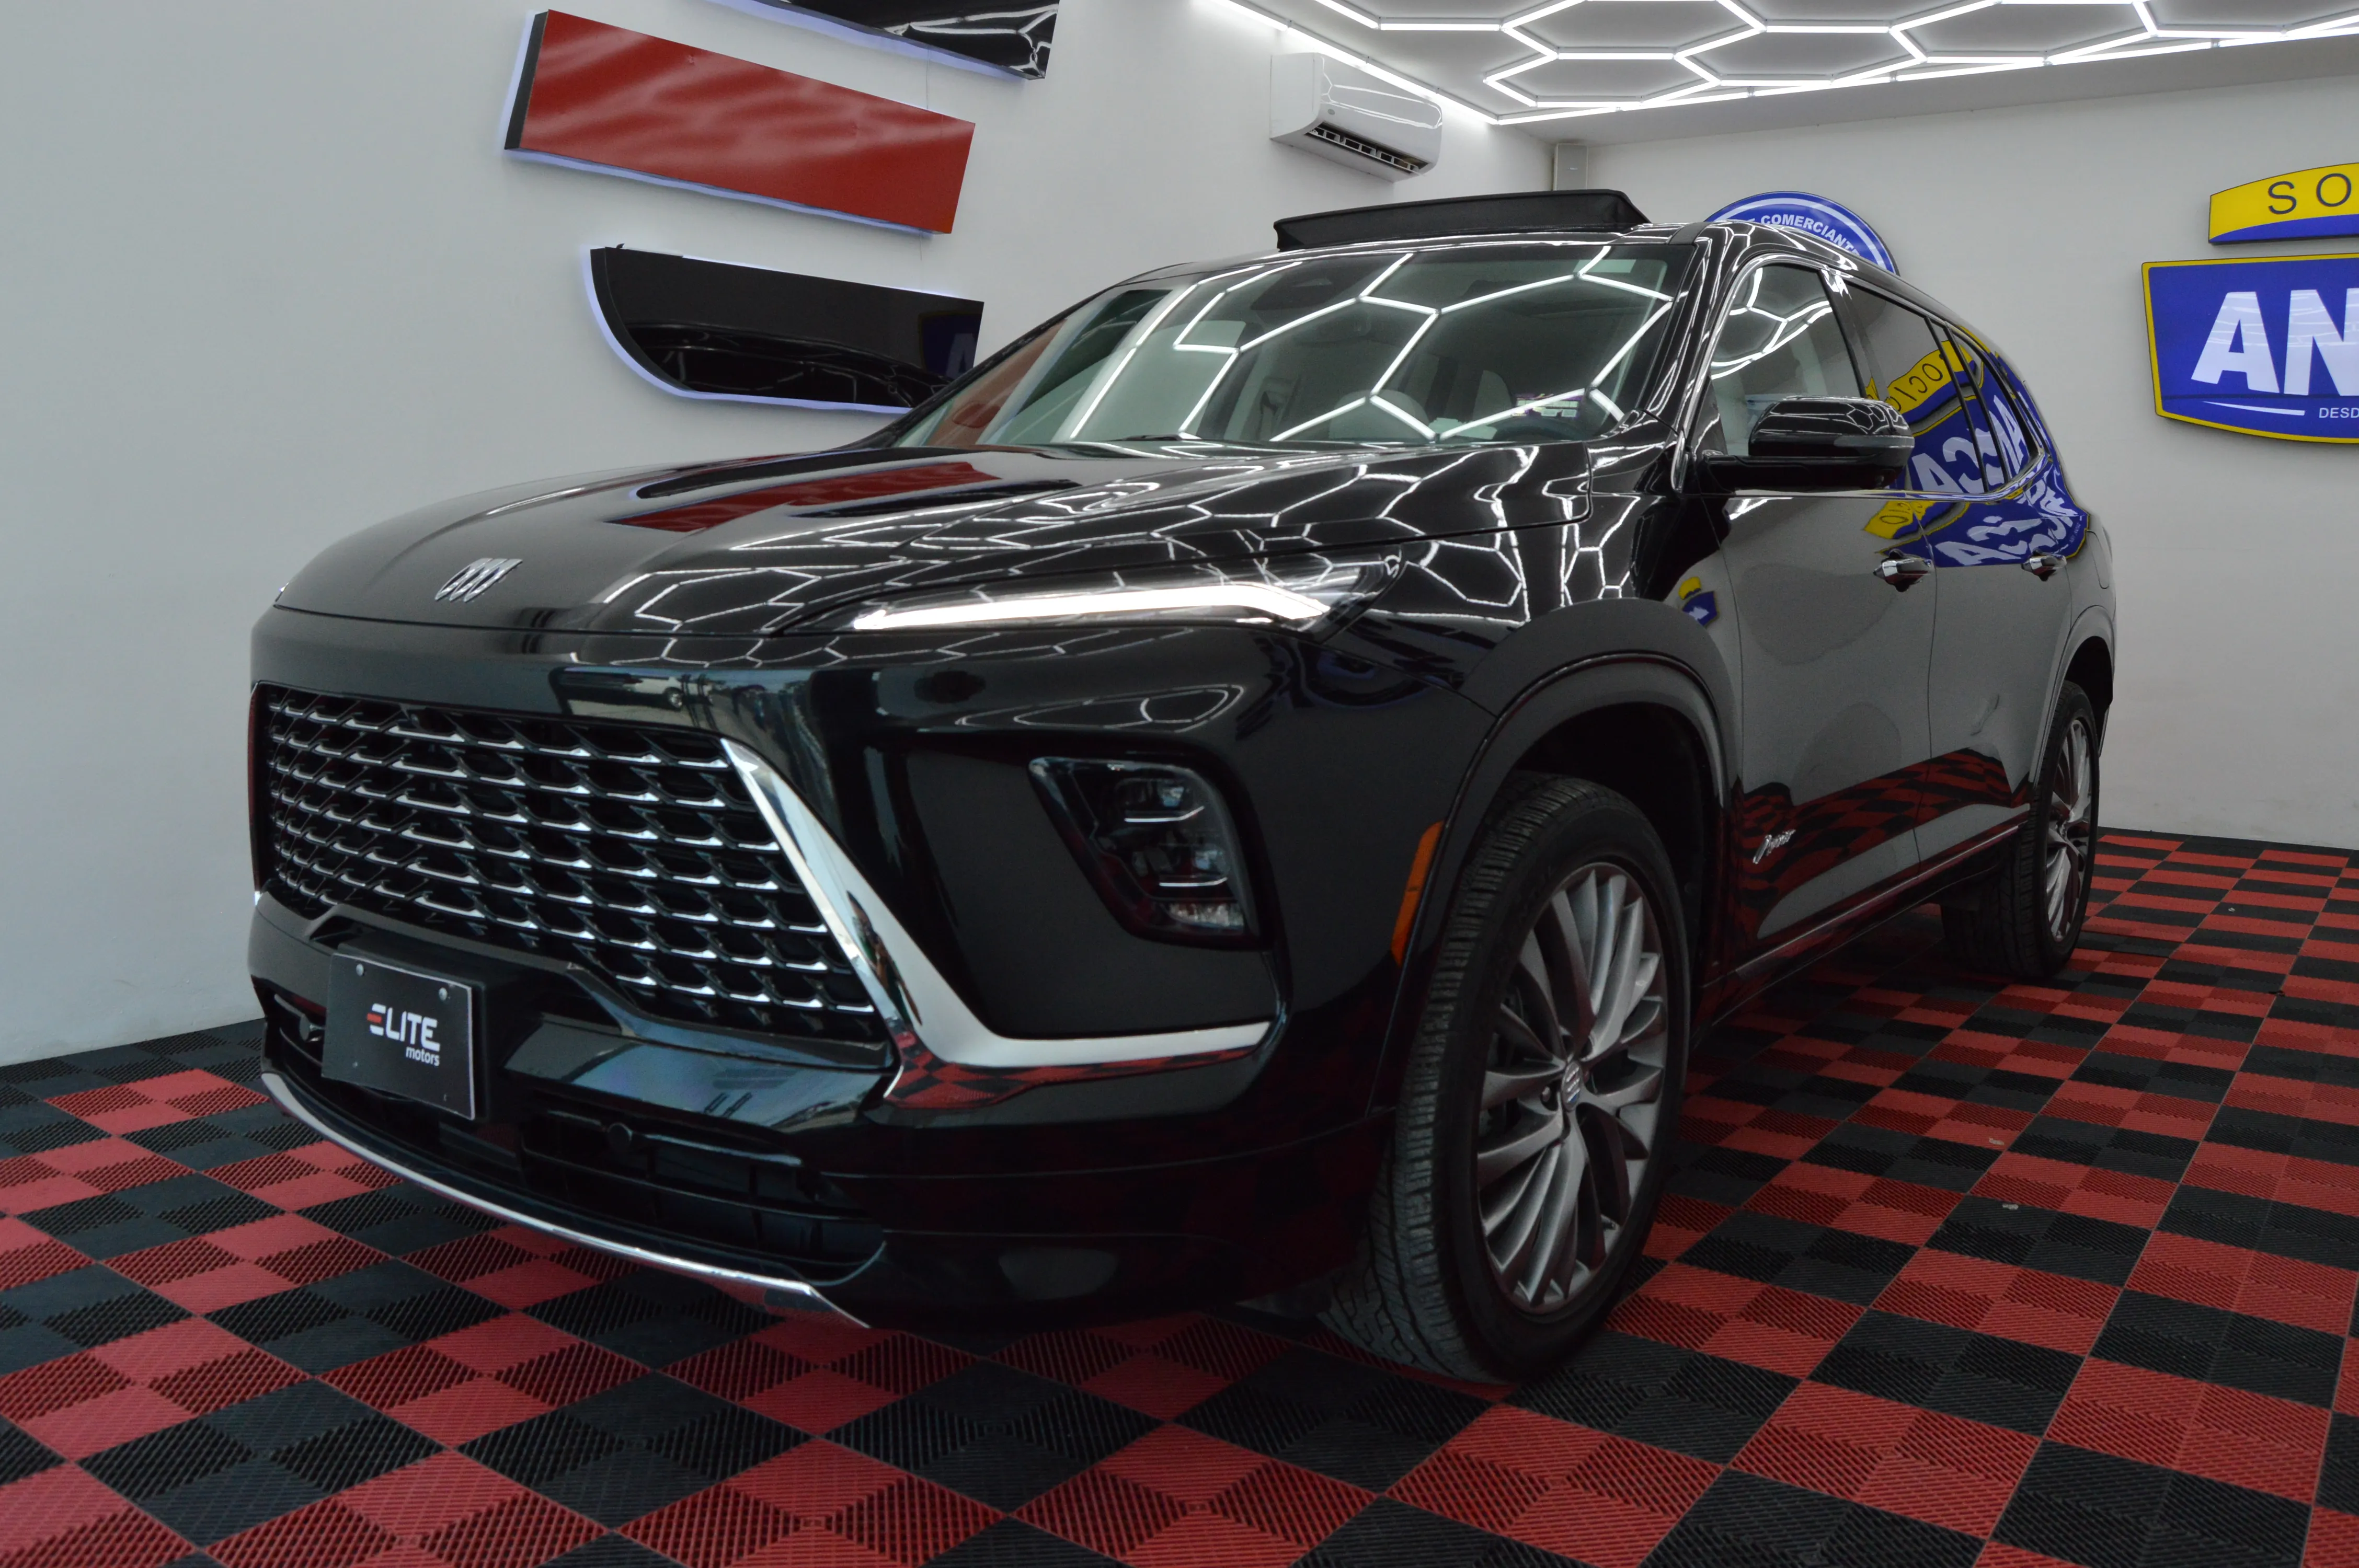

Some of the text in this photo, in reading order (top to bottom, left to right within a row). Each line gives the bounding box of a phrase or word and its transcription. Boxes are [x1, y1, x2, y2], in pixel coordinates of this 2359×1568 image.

[2268, 173, 2352, 214] SO
[2191, 287, 2359, 396] AN
[2319, 407, 2359, 418] DESD
[367, 1003, 440, 1052] ELITE
[405, 1046, 440, 1066] motors
